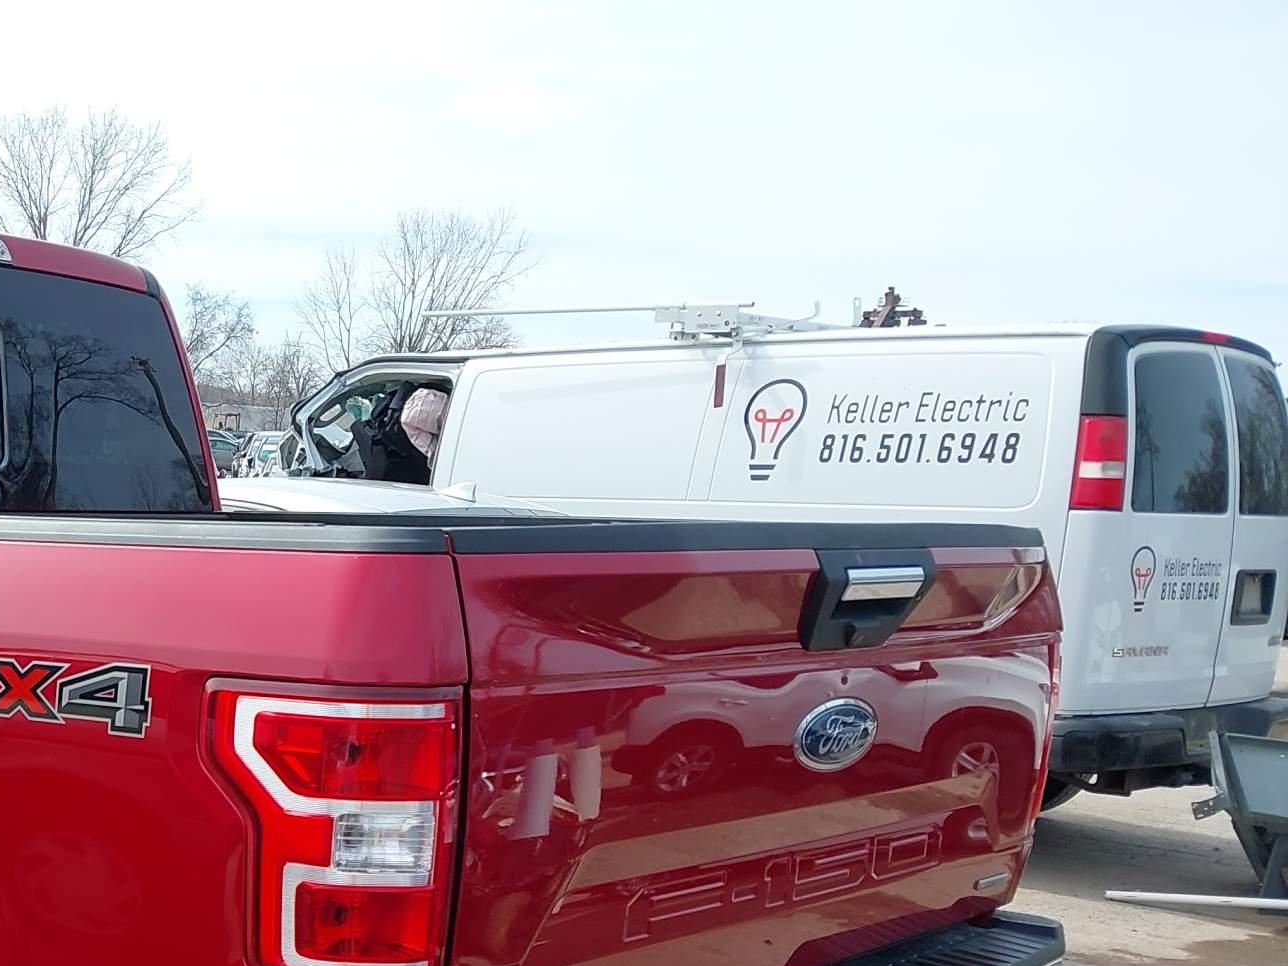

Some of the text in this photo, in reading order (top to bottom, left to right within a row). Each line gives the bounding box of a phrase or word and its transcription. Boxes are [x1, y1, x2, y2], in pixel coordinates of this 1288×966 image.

[827, 391, 1030, 424] Keller Electric
[818, 432, 1021, 464] 816.501.6948
[1163, 557, 1223, 577] Keller Electric
[622, 822, 944, 943] F-150
